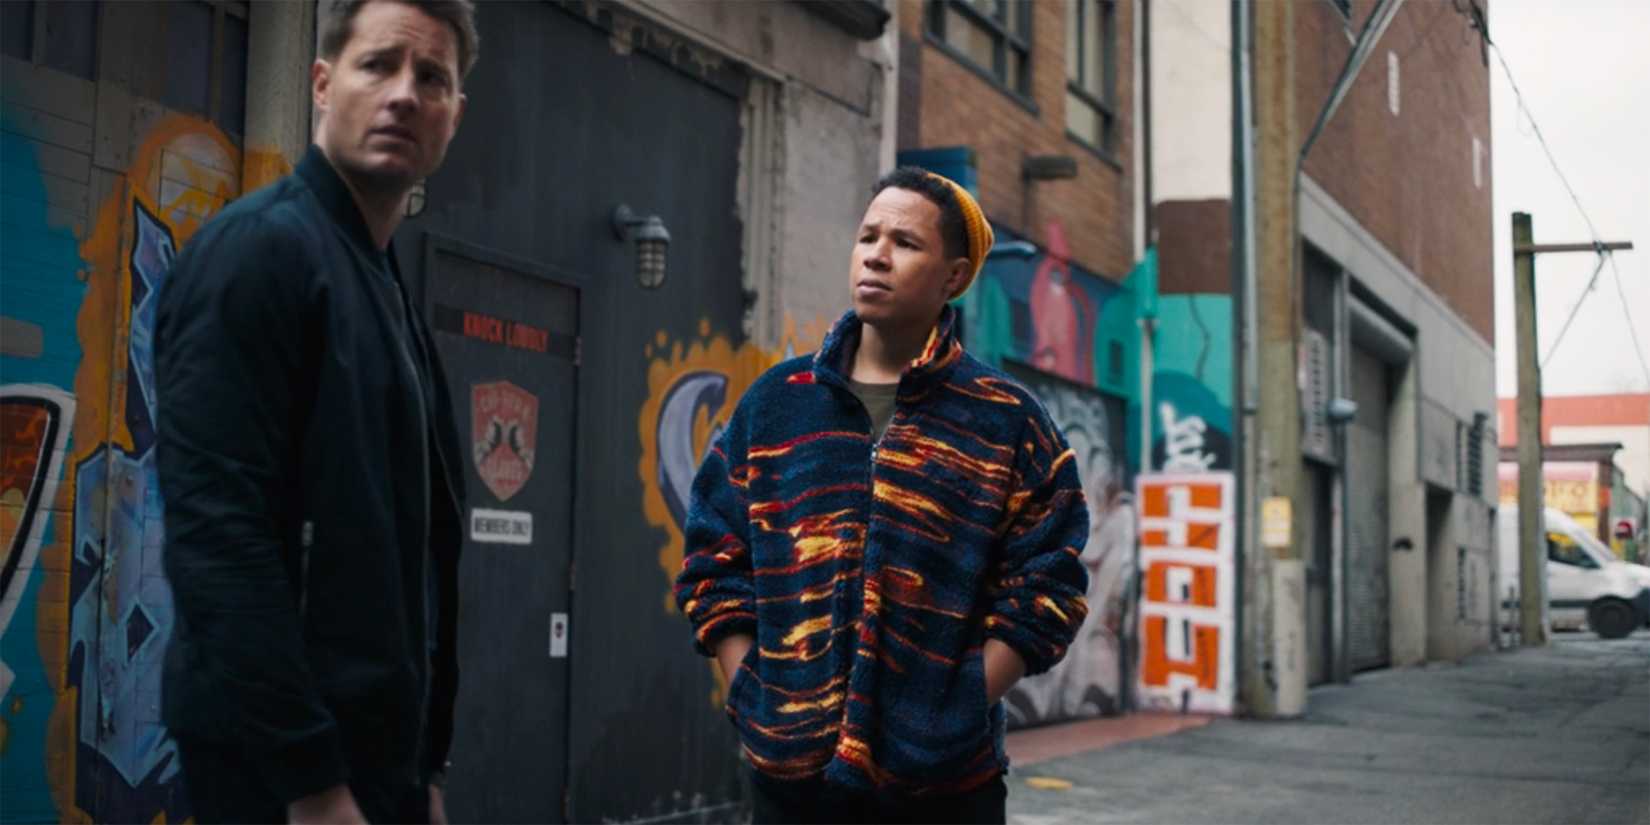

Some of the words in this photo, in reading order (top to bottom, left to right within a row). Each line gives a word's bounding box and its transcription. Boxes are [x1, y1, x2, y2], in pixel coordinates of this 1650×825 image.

[463, 312, 504, 343] KNOCK
[506, 322, 549, 352] LOUDLY
[474, 517, 511, 536] MEMBERS
[512, 519, 530, 537] ONLY
